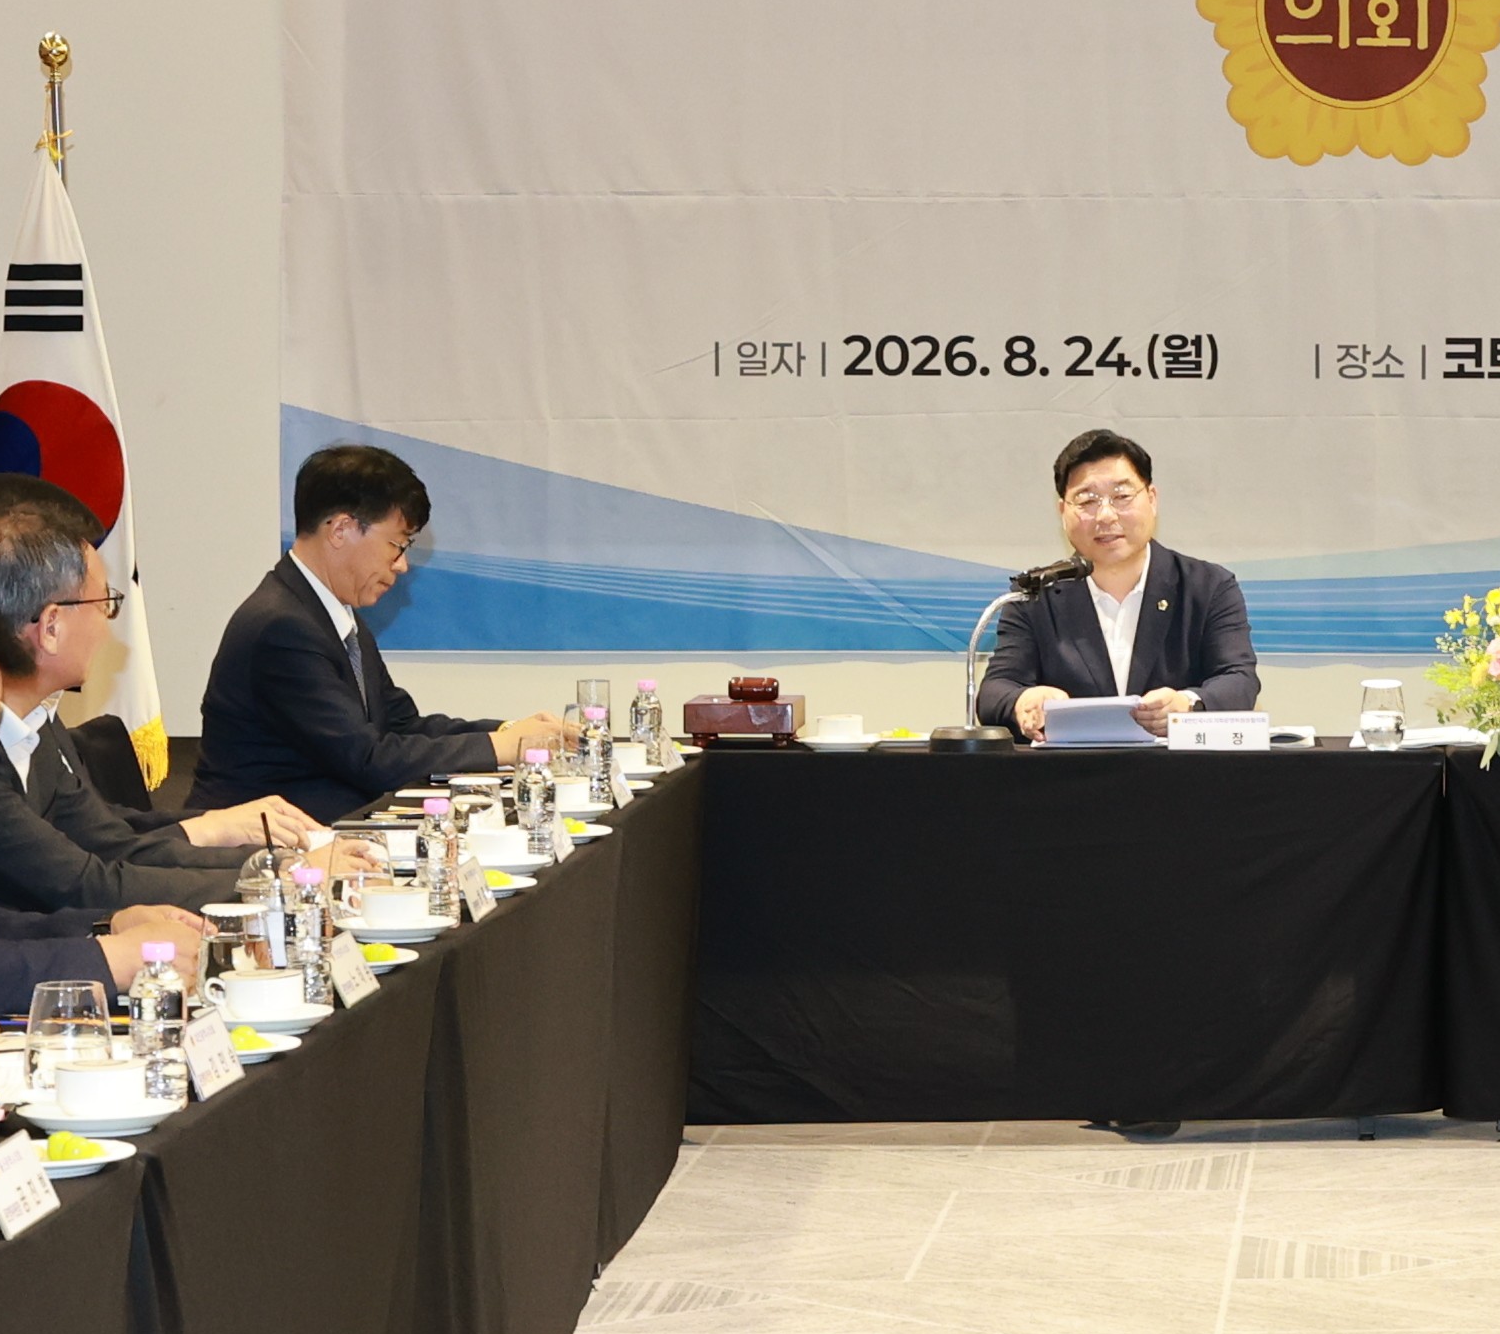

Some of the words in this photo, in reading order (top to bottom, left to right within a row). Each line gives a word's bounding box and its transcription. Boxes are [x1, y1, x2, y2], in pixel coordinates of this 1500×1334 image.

[736, 341, 807, 377] 일자
[842, 334, 990, 377] 2026.
[1003, 335, 1050, 377] 8.
[1063, 333, 1219, 380] 24.(월)
[1336, 343, 1406, 380] 장소
